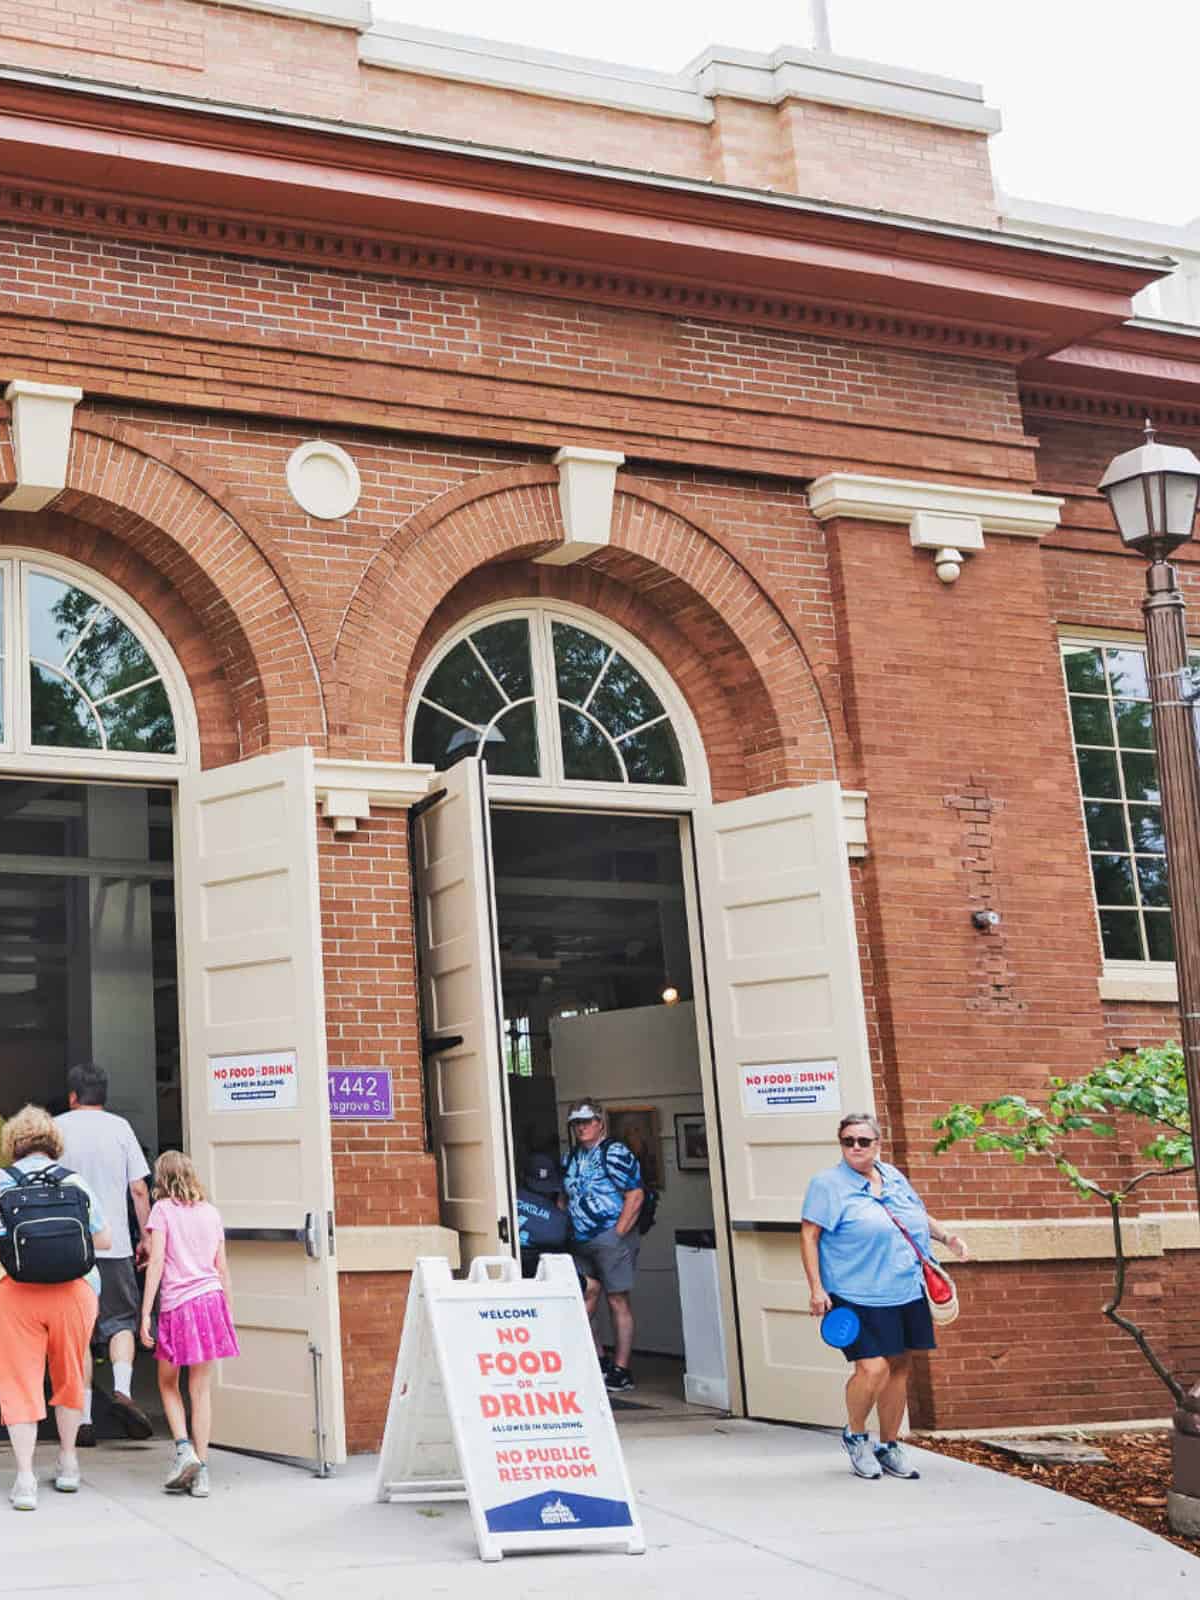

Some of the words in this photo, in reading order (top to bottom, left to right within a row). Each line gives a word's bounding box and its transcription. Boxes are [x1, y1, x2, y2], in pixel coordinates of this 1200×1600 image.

[214, 1069, 227, 1080] NO
[229, 1066, 255, 1078] FOOD
[262, 1063, 293, 1077] DRINK
[746, 1075, 761, 1086] NO
[764, 1074, 792, 1085] FOOD
[800, 1071, 835, 1082] DRINK
[328, 1076, 377, 1097] 1442
[329, 1101, 369, 1113] osgrove
[479, 1308, 538, 1320] WELCOME
[496, 1326, 530, 1345] NO
[477, 1350, 562, 1377] FOOD
[517, 1379, 534, 1389] OR
[479, 1391, 583, 1419] DRINK
[492, 1422, 531, 1433] ALLOWED
[542, 1421, 584, 1431] BUILDING
[496, 1449, 522, 1464] NO
[526, 1446, 592, 1463] PUBLIC
[498, 1463, 597, 1482] RESTROOM
